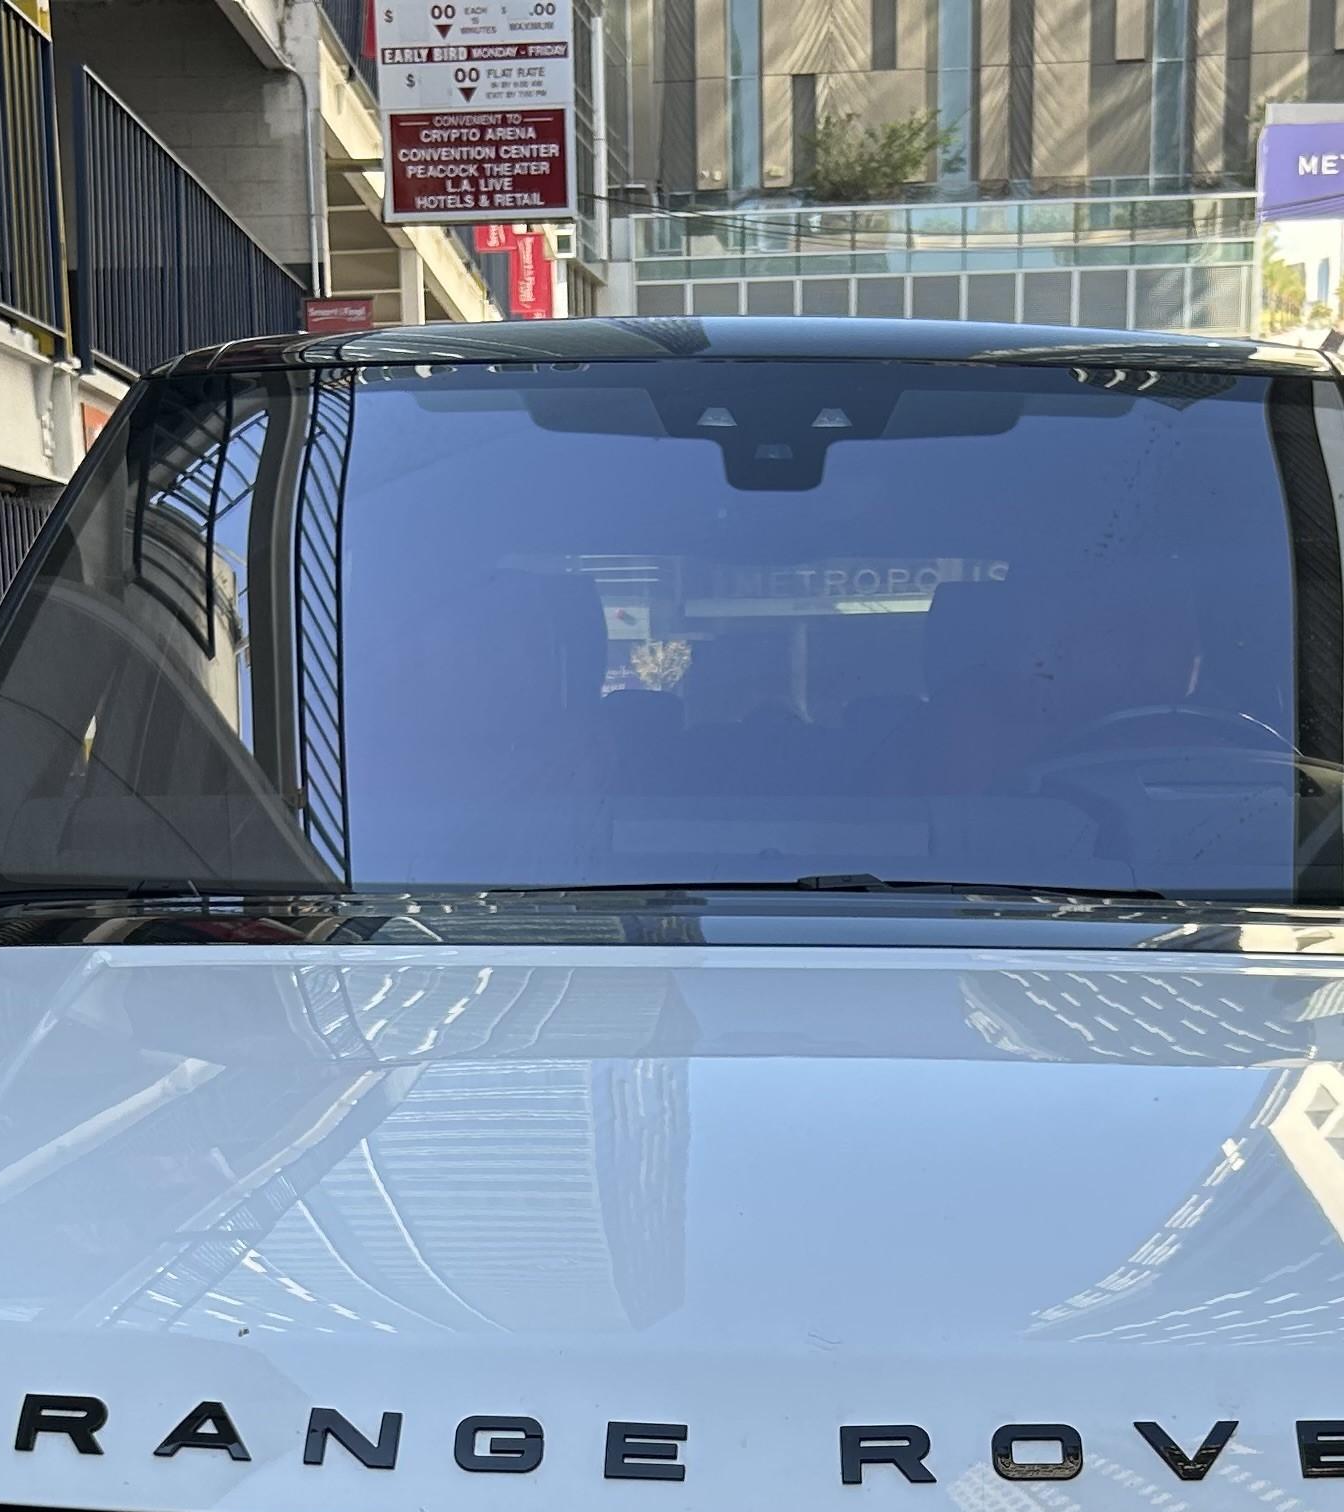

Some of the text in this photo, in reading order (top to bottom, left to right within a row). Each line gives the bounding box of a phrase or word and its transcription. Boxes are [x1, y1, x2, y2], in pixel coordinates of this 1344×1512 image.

[384, 49, 429, 63] EARLY
[433, 46, 467, 62] BIRD
[472, 47, 517, 59] MONDAY
[528, 44, 567, 57] FRIDAY
[487, 67, 513, 78] FLAT
[517, 66, 545, 77] RATE
[433, 113, 522, 127] CONVENIENT TO
[420, 127, 536, 142] CRYPTO ARENA
[398, 144, 560, 161] CONVENTION CENTER
[407, 162, 550, 178] PEACOCK THEATER
[445, 177, 513, 193] L.A. LIVE
[415, 192, 545, 209] HOTELS & RETAIL
[15, 1393, 689, 1481] RANGE
